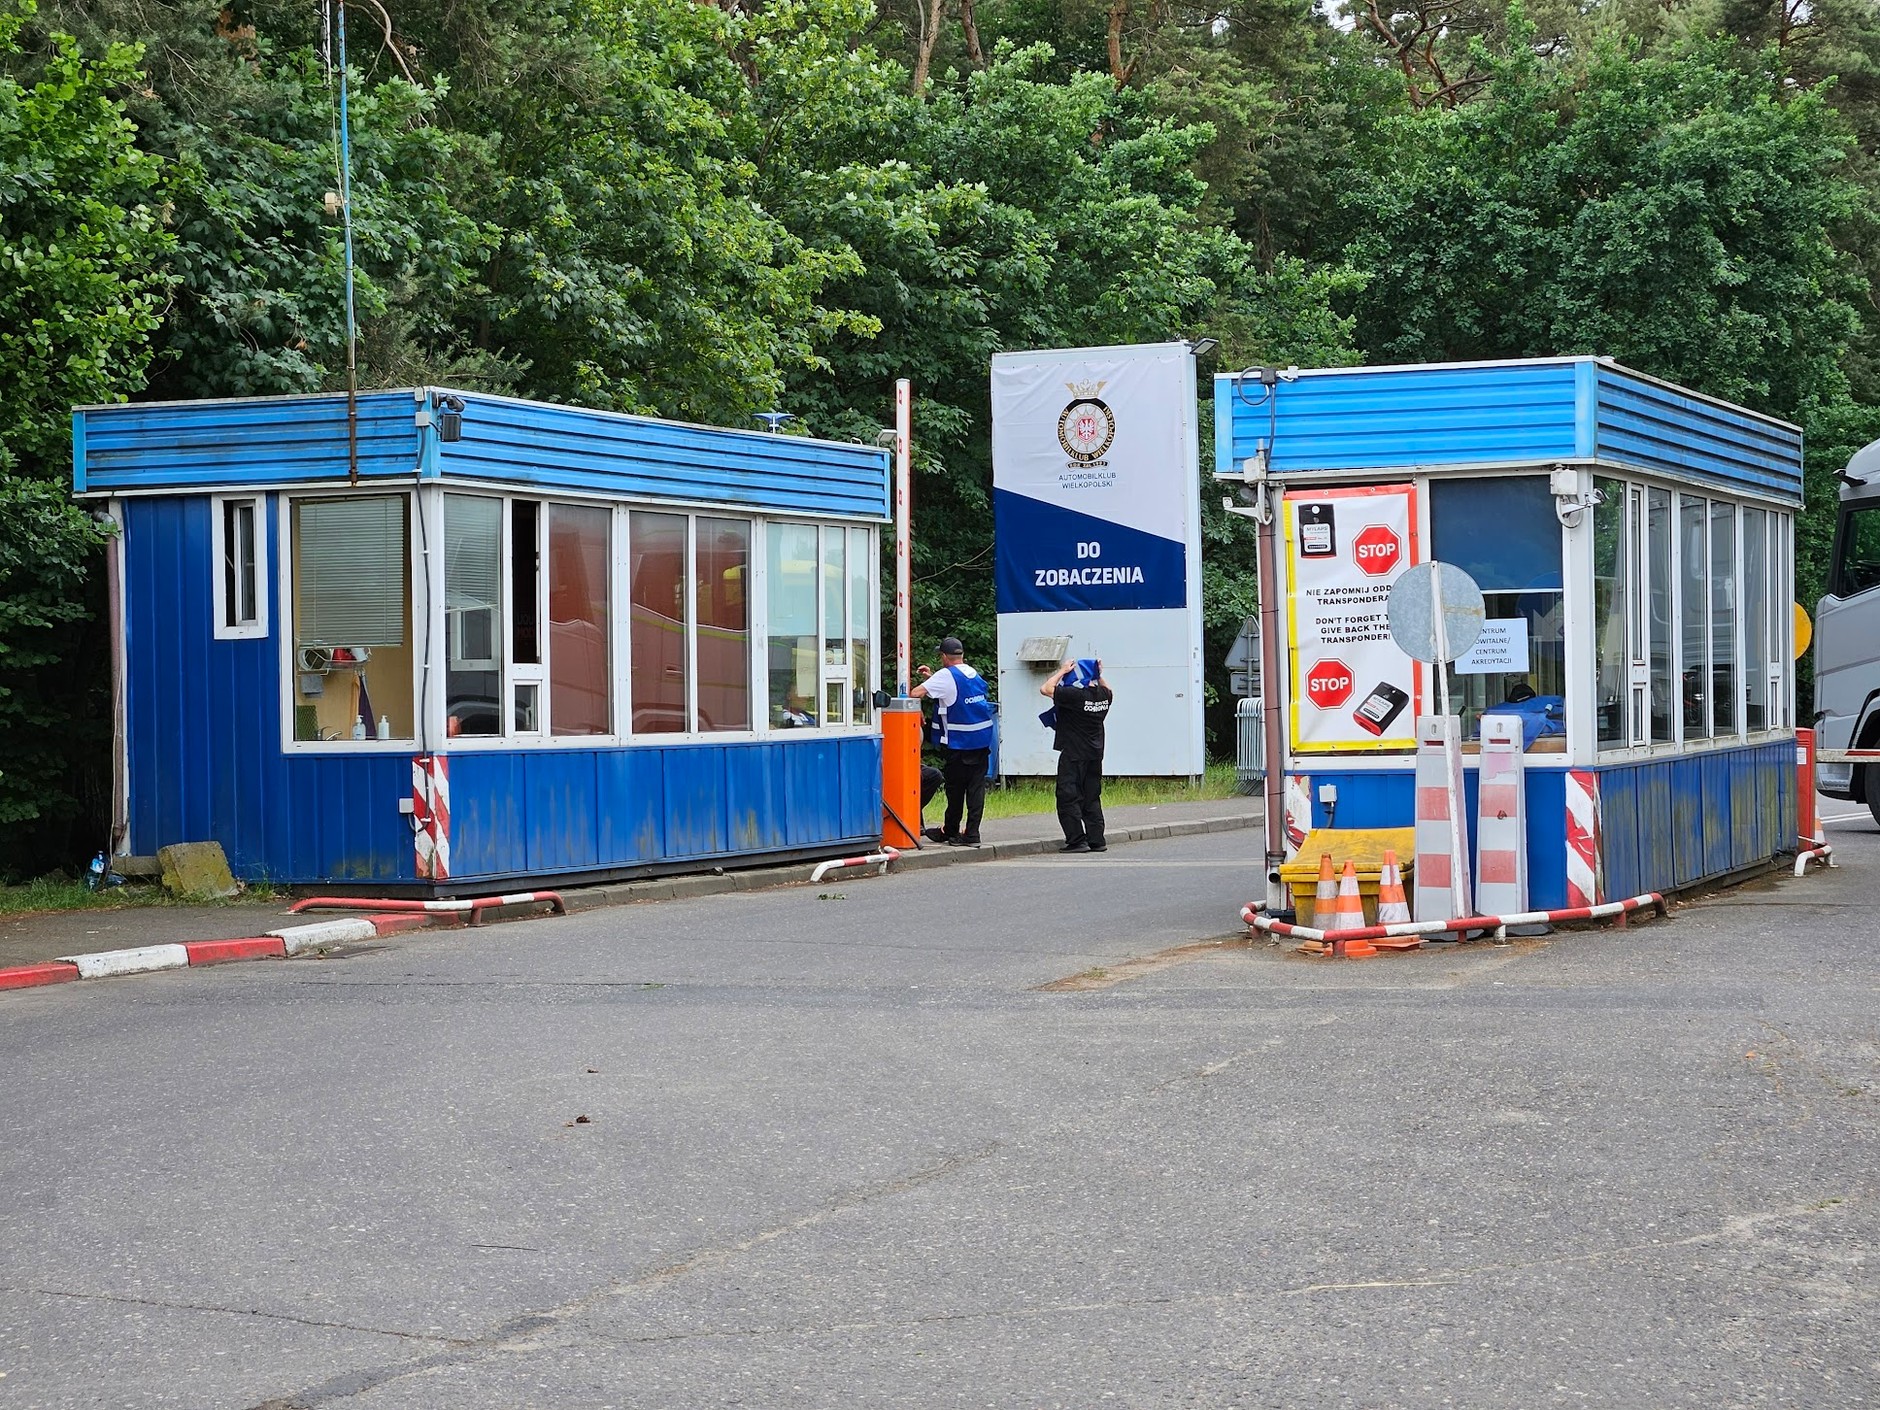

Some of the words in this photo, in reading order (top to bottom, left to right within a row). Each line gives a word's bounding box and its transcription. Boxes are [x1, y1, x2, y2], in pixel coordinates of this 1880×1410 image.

[1057, 408, 1090, 462] AUTOMOBILKLUB
[1091, 406, 1116, 460] WIELKOPOLSKI
[1058, 472, 1117, 481] AUTOMOBILKLUB
[1061, 480, 1113, 489] WIELKOPOLSKI
[1077, 541, 1101, 559] DO
[1358, 543, 1396, 558] STOP
[1035, 566, 1144, 587] ZOBACZENIA
[1324, 586, 1370, 595] ZAPOMNIJ
[1372, 585, 1392, 593] ODD
[1315, 617, 1342, 625] DON'T
[1345, 614, 1381, 624] FORGET
[1320, 626, 1342, 634] GIVE
[1345, 625, 1370, 633] BACK
[1475, 637, 1511, 645] OWITALNE/
[1310, 676, 1350, 692] STOP
